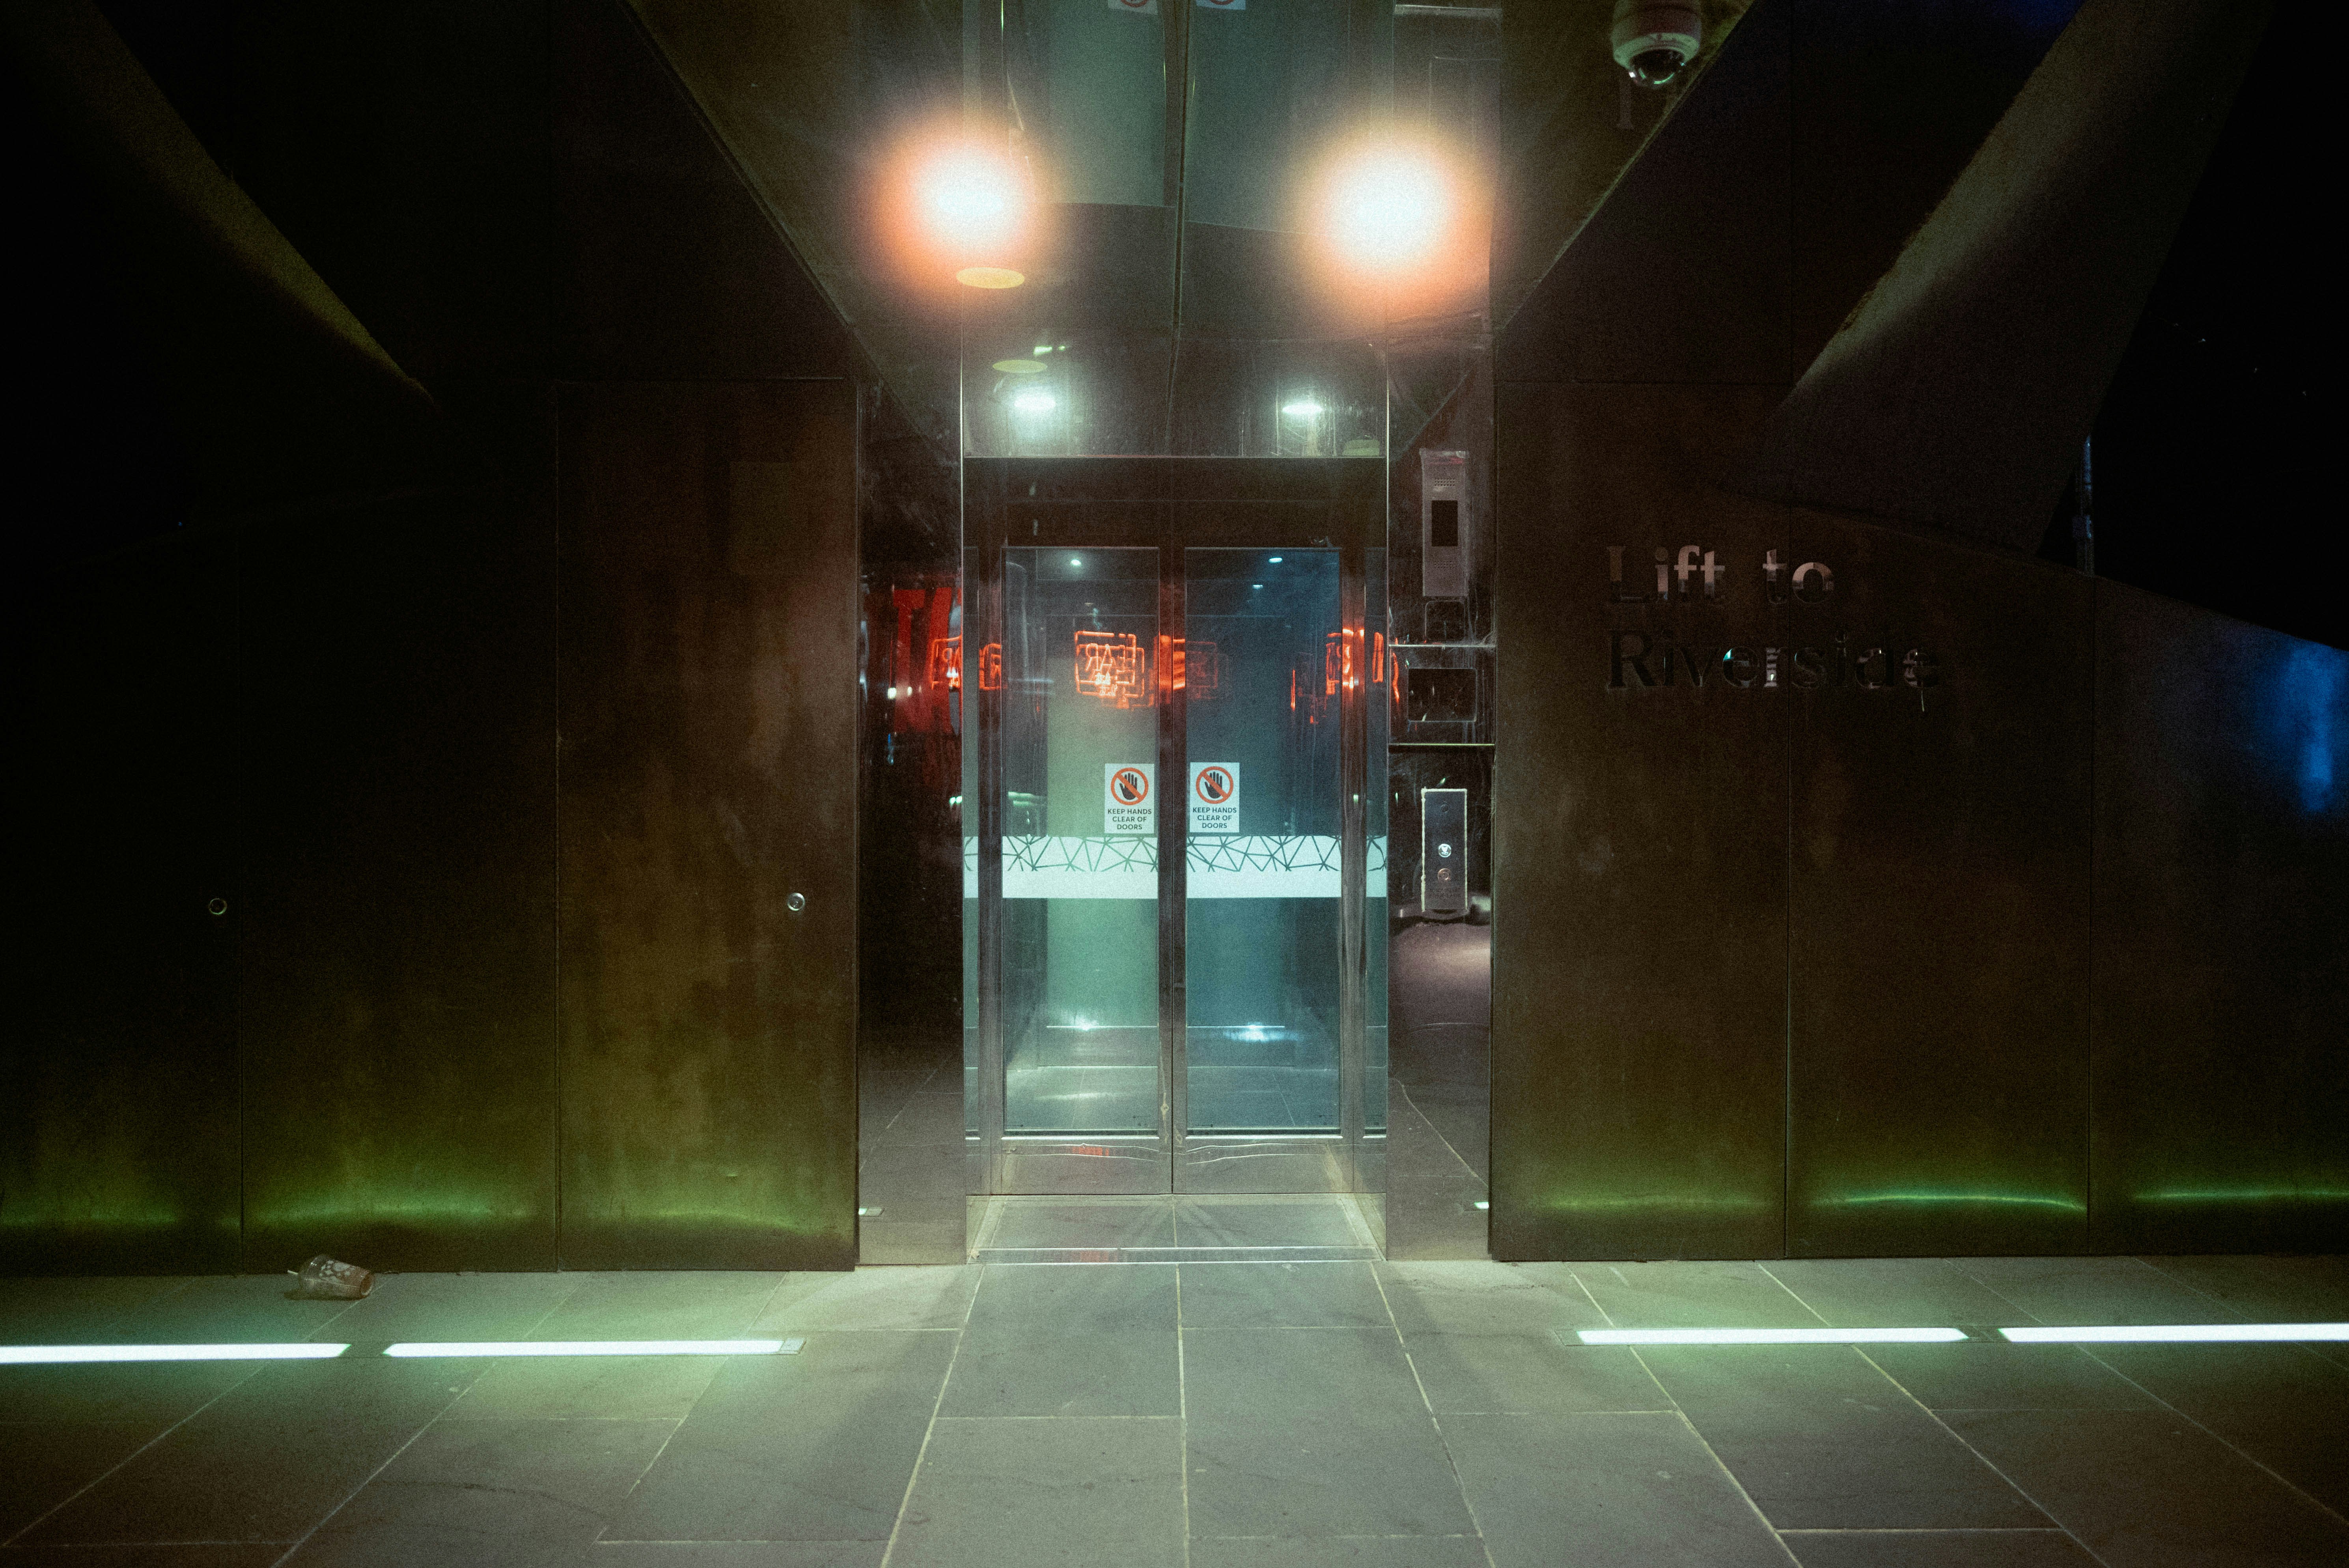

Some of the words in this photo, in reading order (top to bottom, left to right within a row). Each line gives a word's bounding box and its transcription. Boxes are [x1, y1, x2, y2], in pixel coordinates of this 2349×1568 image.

[1606, 544, 1726, 604] Lift
[1762, 549, 1834, 604] to
[1607, 629, 1940, 691] Riverside
